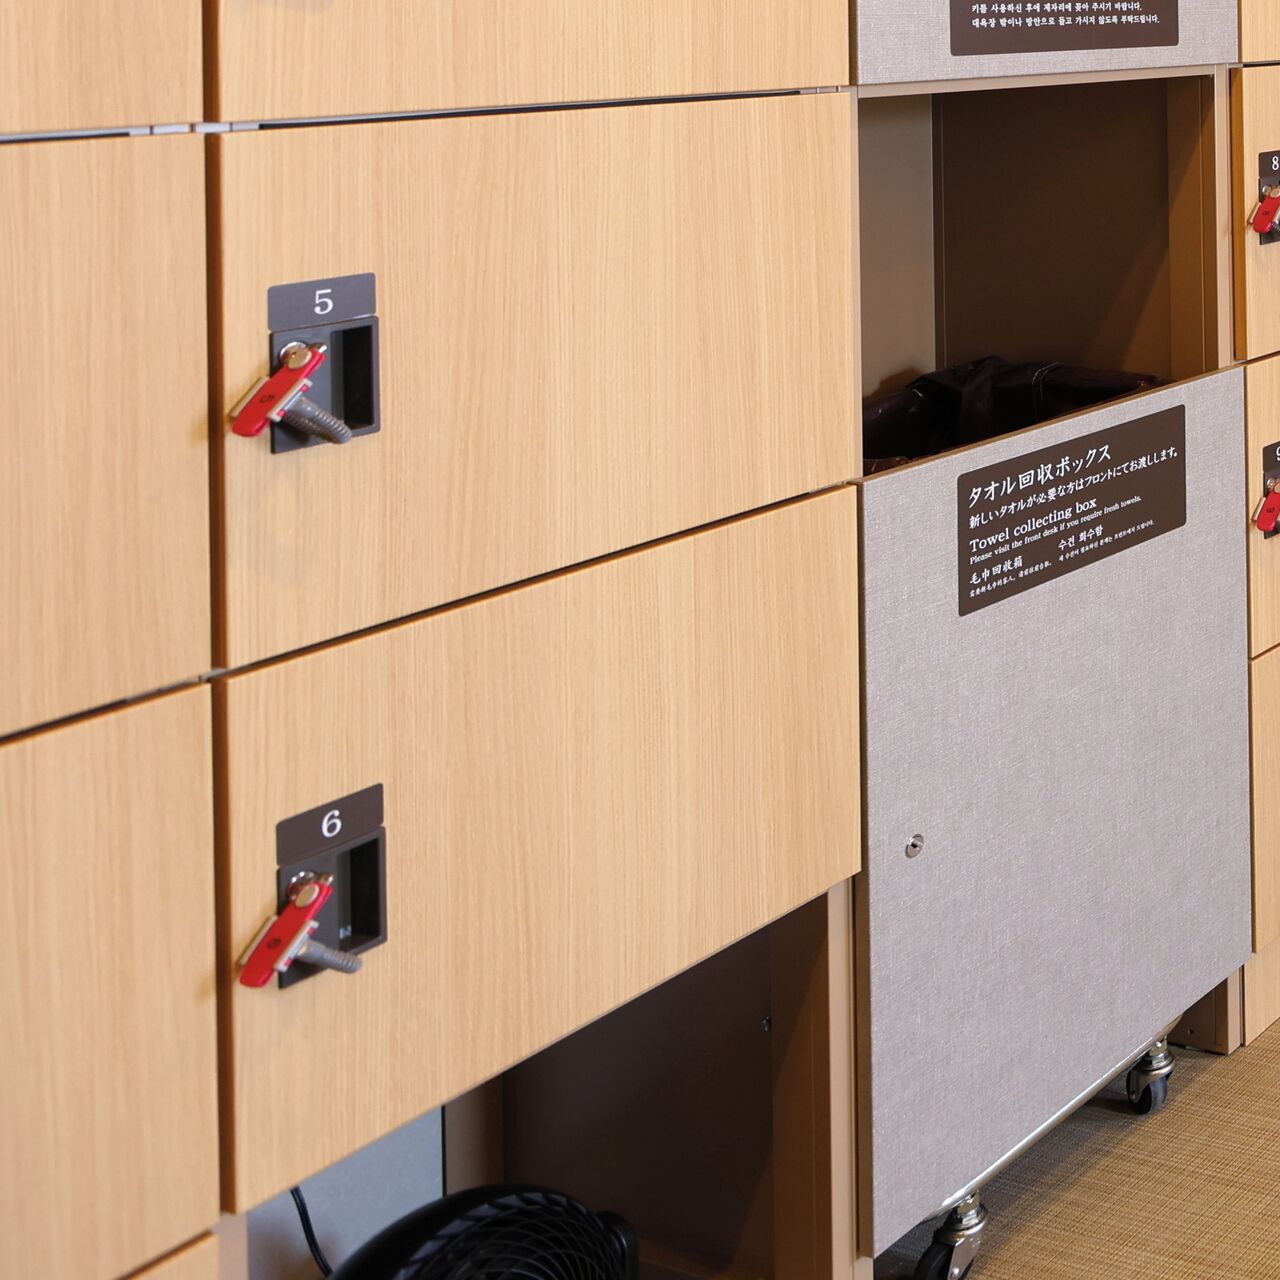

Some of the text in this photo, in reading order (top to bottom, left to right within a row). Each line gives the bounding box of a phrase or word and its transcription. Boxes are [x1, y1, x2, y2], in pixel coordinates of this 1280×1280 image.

[1272, 156, 1280, 170] 8
[314, 288, 334, 314] 5
[968, 444, 1111, 508] タオル回収ボックス
[969, 446, 1177, 529] 新しいタオルが必要な方はフロントにてお渡しします。
[969, 497, 1141, 565] Please visit the front desk if you require fresh towels.
[970, 501, 1097, 552] Towel collecting box
[322, 810, 342, 838] 6
